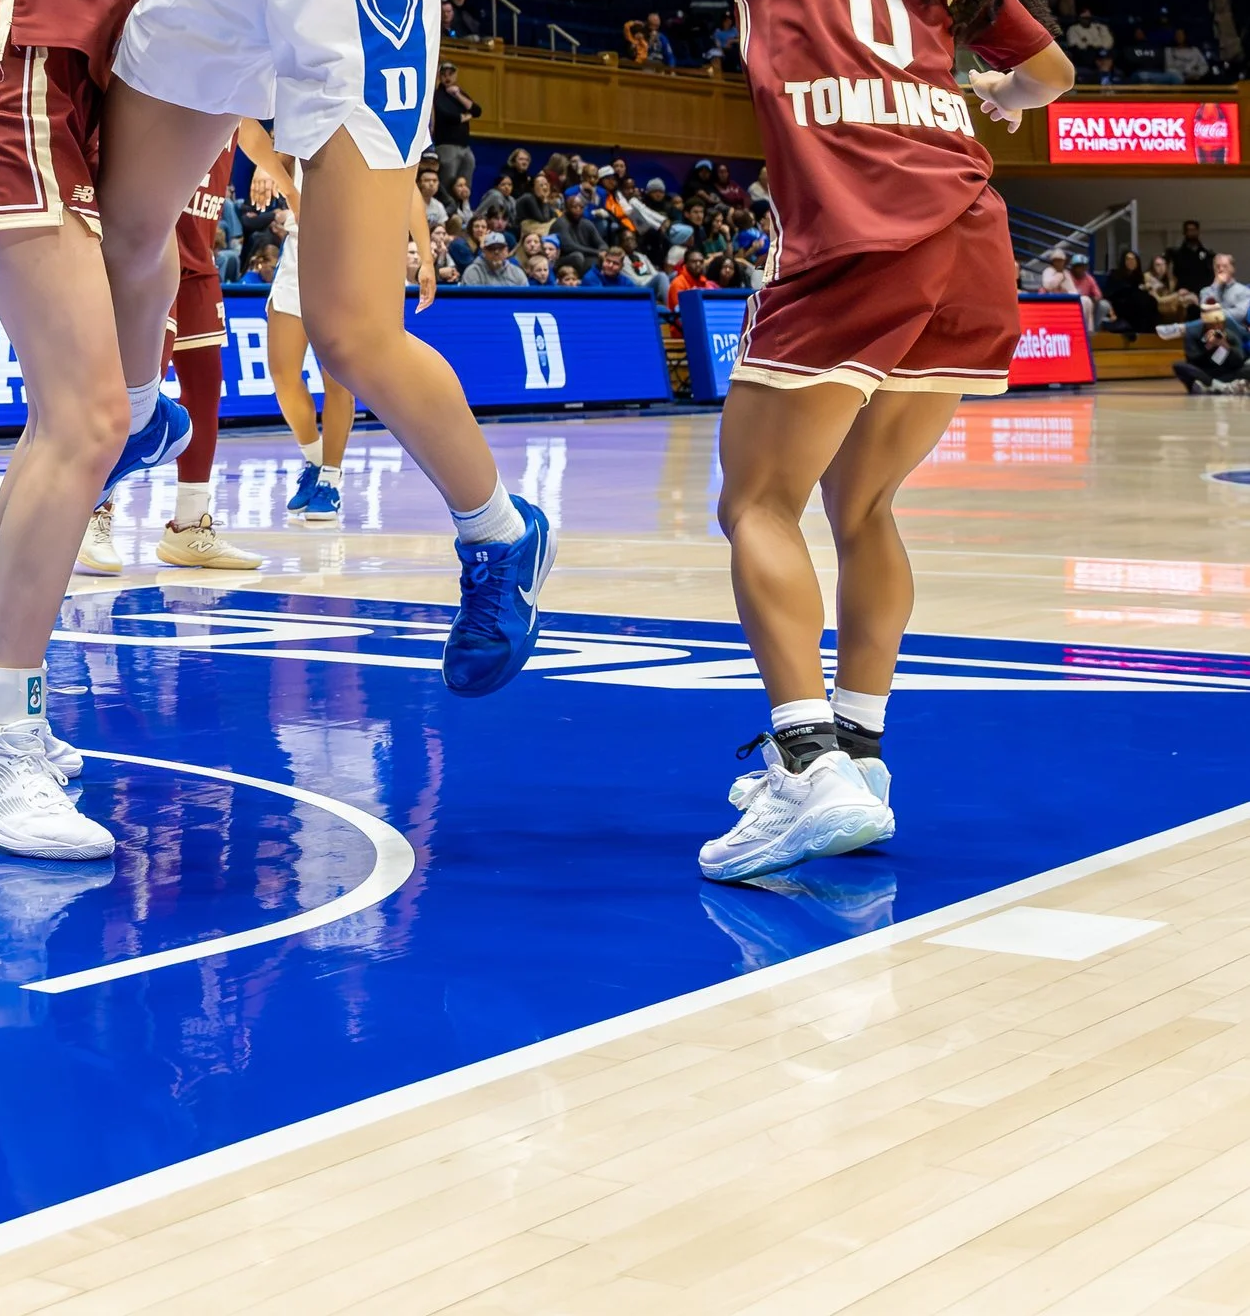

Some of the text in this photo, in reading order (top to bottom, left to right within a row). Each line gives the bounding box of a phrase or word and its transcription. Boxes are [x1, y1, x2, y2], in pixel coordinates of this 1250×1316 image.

[380, 67, 418, 111] D
[1058, 118, 1185, 138] FAN WORK
[1059, 138, 1186, 151] IS THIRSTY WORK
[514, 312, 566, 390] D
